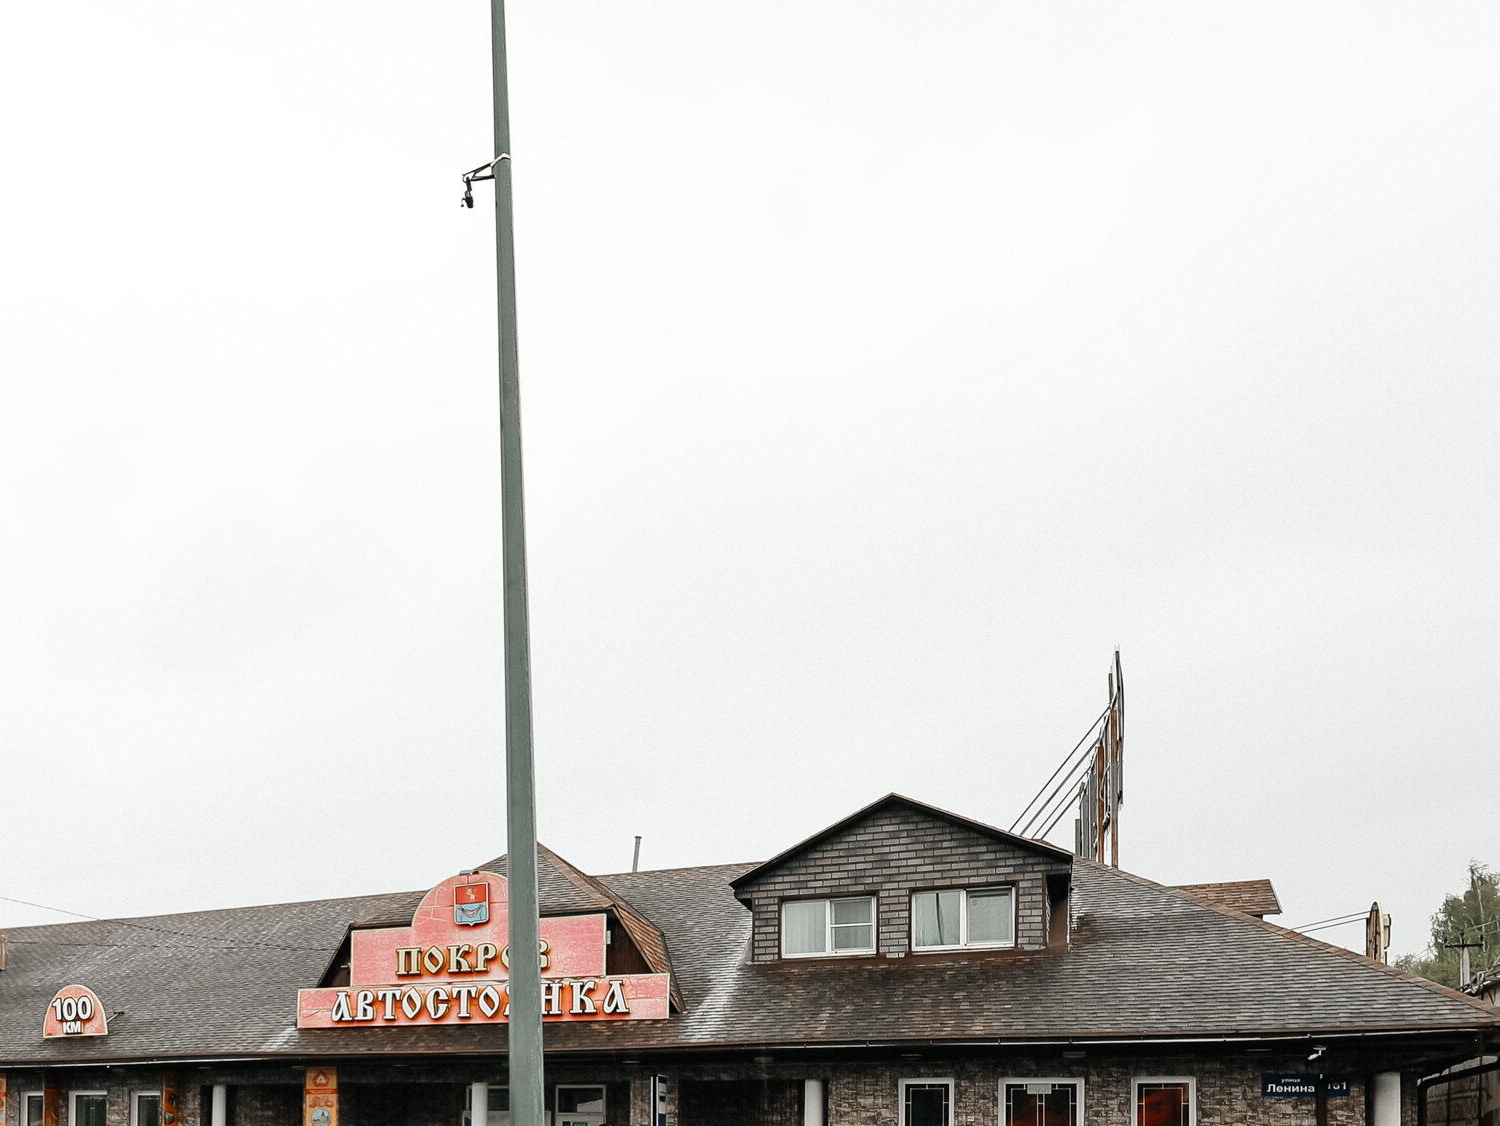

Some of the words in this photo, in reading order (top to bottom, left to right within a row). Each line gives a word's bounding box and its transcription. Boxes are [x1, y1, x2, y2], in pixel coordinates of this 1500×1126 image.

[52, 995, 92, 1021] 100
[330, 979, 630, 1022] АВТОСТОНКА
[1266, 1083, 1316, 1093] Ленина
